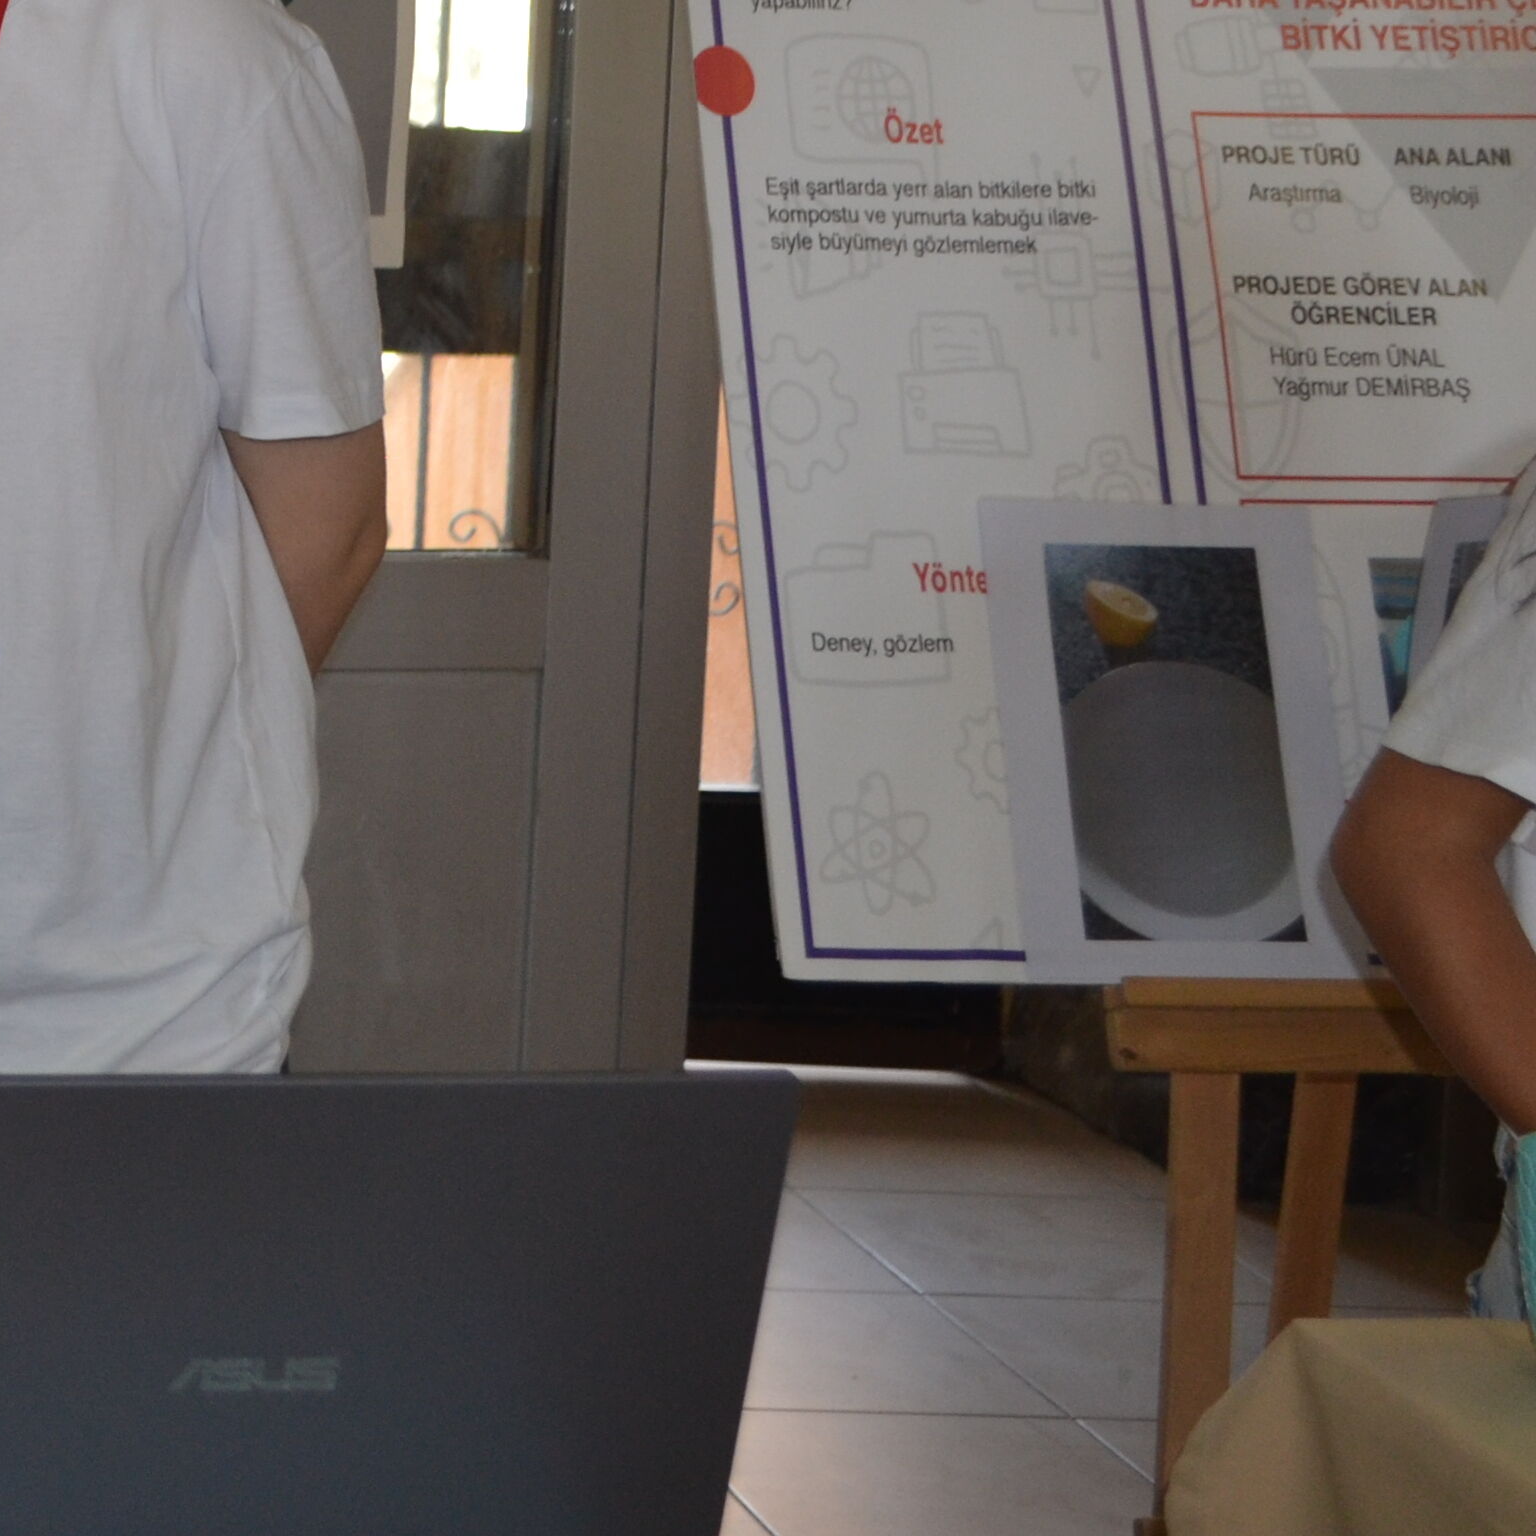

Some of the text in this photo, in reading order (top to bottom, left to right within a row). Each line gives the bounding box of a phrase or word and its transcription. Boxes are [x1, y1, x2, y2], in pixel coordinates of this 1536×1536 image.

[1280, 18, 1362, 51] BİTKİ
[884, 107, 944, 144] Özet
[1221, 143, 1360, 166] PROJE TÜRÜ
[1394, 147, 1512, 166] ANA ALANI
[765, 177, 1096, 200] Eşit şartlarda alan bitkilere bitki
[767, 205, 859, 229] kompostu
[864, 211, 886, 225] ve
[892, 209, 966, 230] yumurta
[972, 207, 1042, 230] kabuğu
[771, 234, 1037, 256] siyle büyümeyi gözlemlemek
[1233, 273, 1487, 297] PROJEDE GÖREV ALAN
[1291, 301, 1437, 326] ÖĞRENCİLER
[883, 633, 955, 658] gözlem
[169, 1357, 340, 1391] ASUS
